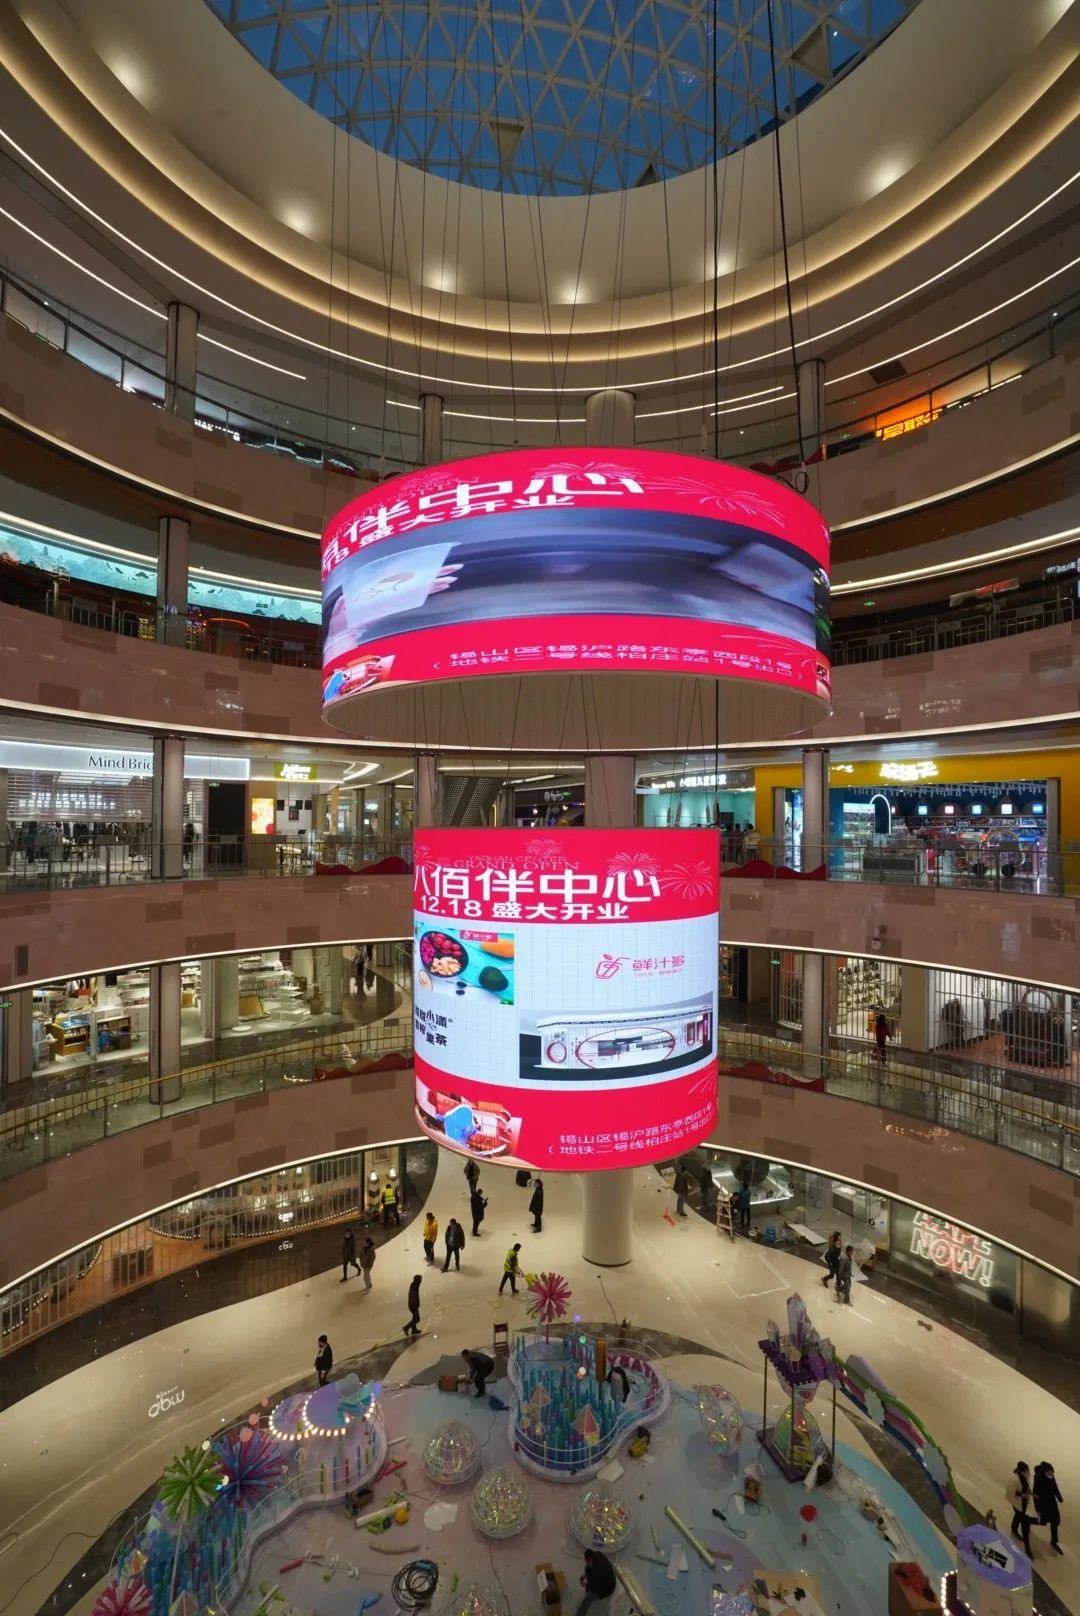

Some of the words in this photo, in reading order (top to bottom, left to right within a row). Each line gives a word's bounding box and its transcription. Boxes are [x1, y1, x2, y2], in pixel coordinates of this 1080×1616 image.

[88, 755, 125, 769] Mind
[454, 860, 514, 870] GRAND
[523, 861, 579, 871] OPEN
[414, 866, 661, 903] 八佰伴中心
[421, 894, 482, 917] 12.18
[491, 901, 630, 921] 盛大开业
[560, 1102, 712, 1145] 锡山区锡沪路东亭西段1号
